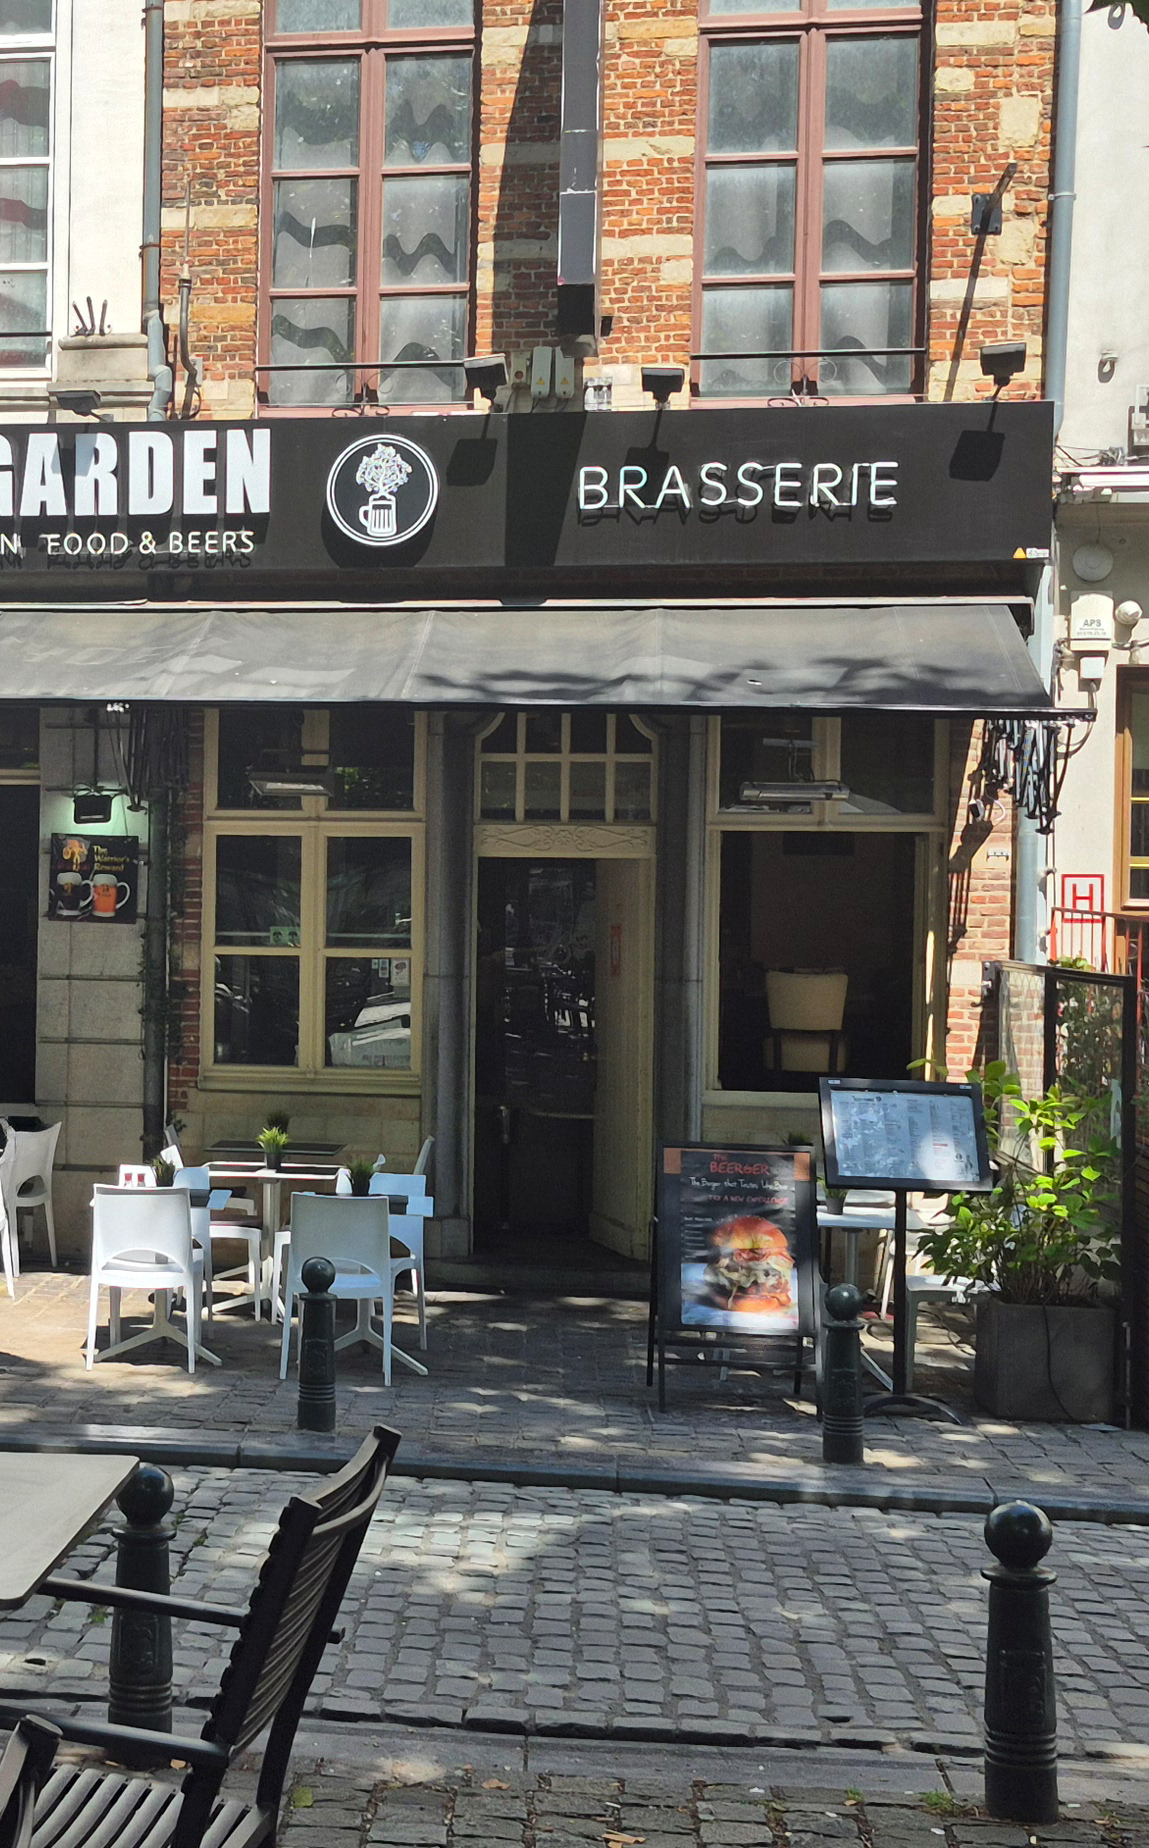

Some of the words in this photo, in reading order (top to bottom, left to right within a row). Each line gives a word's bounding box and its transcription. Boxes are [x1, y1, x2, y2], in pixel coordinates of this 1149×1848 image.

[577, 461, 899, 510] BRASSERIE
[40, 532, 129, 555] FOOD
[139, 531, 156, 554] &
[169, 530, 254, 554] BEERS
[1083, 619, 1102, 627] APS
[93, 845, 109, 854] The
[1072, 883, 1094, 912] H
[709, 1161, 770, 1175] BEERGER
